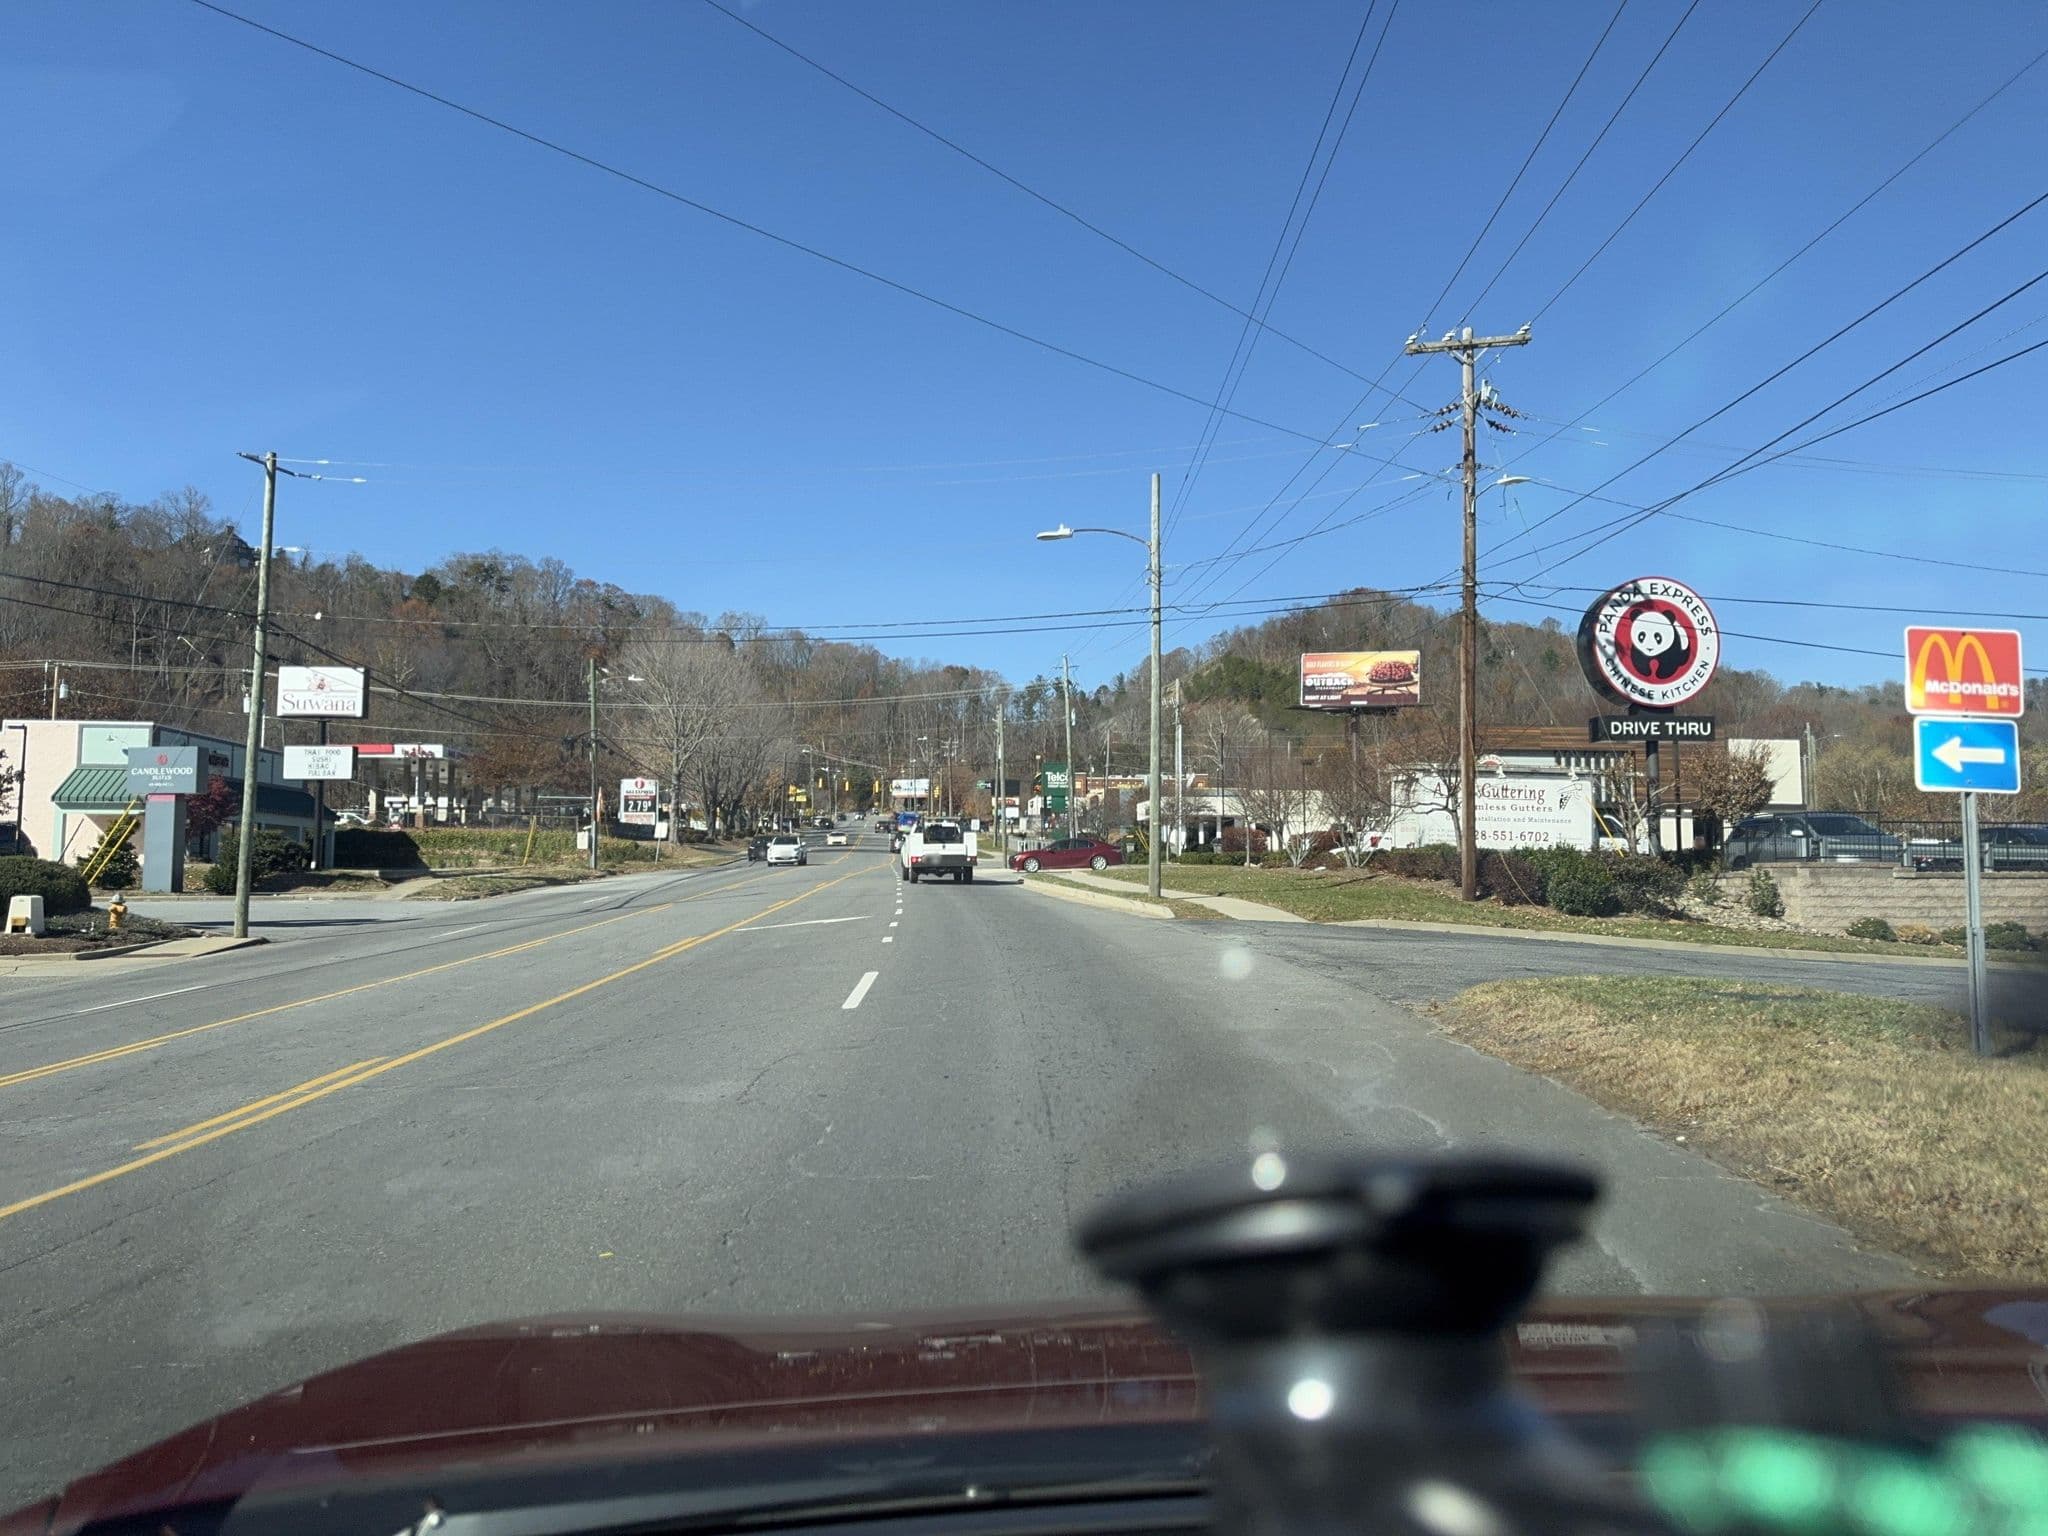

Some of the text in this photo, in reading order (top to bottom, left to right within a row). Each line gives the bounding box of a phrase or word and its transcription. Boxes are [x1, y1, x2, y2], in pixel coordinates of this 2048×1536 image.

[1599, 583, 1713, 636] PANDA EXPRESS
[1304, 678, 1355, 687] OUTBACK
[1605, 657, 1710, 699] CHINESE KITCHEN
[1925, 680, 2019, 697] McDonald's
[282, 693, 356, 712] Suwana
[1610, 721, 1711, 736] DRIVE THRU
[131, 767, 193, 775] CANDLEWOOD
[1481, 782, 1545, 804] Guttering
[1510, 804, 1553, 812] Gutters
[1475, 831, 1549, 842] 28-551-6702
